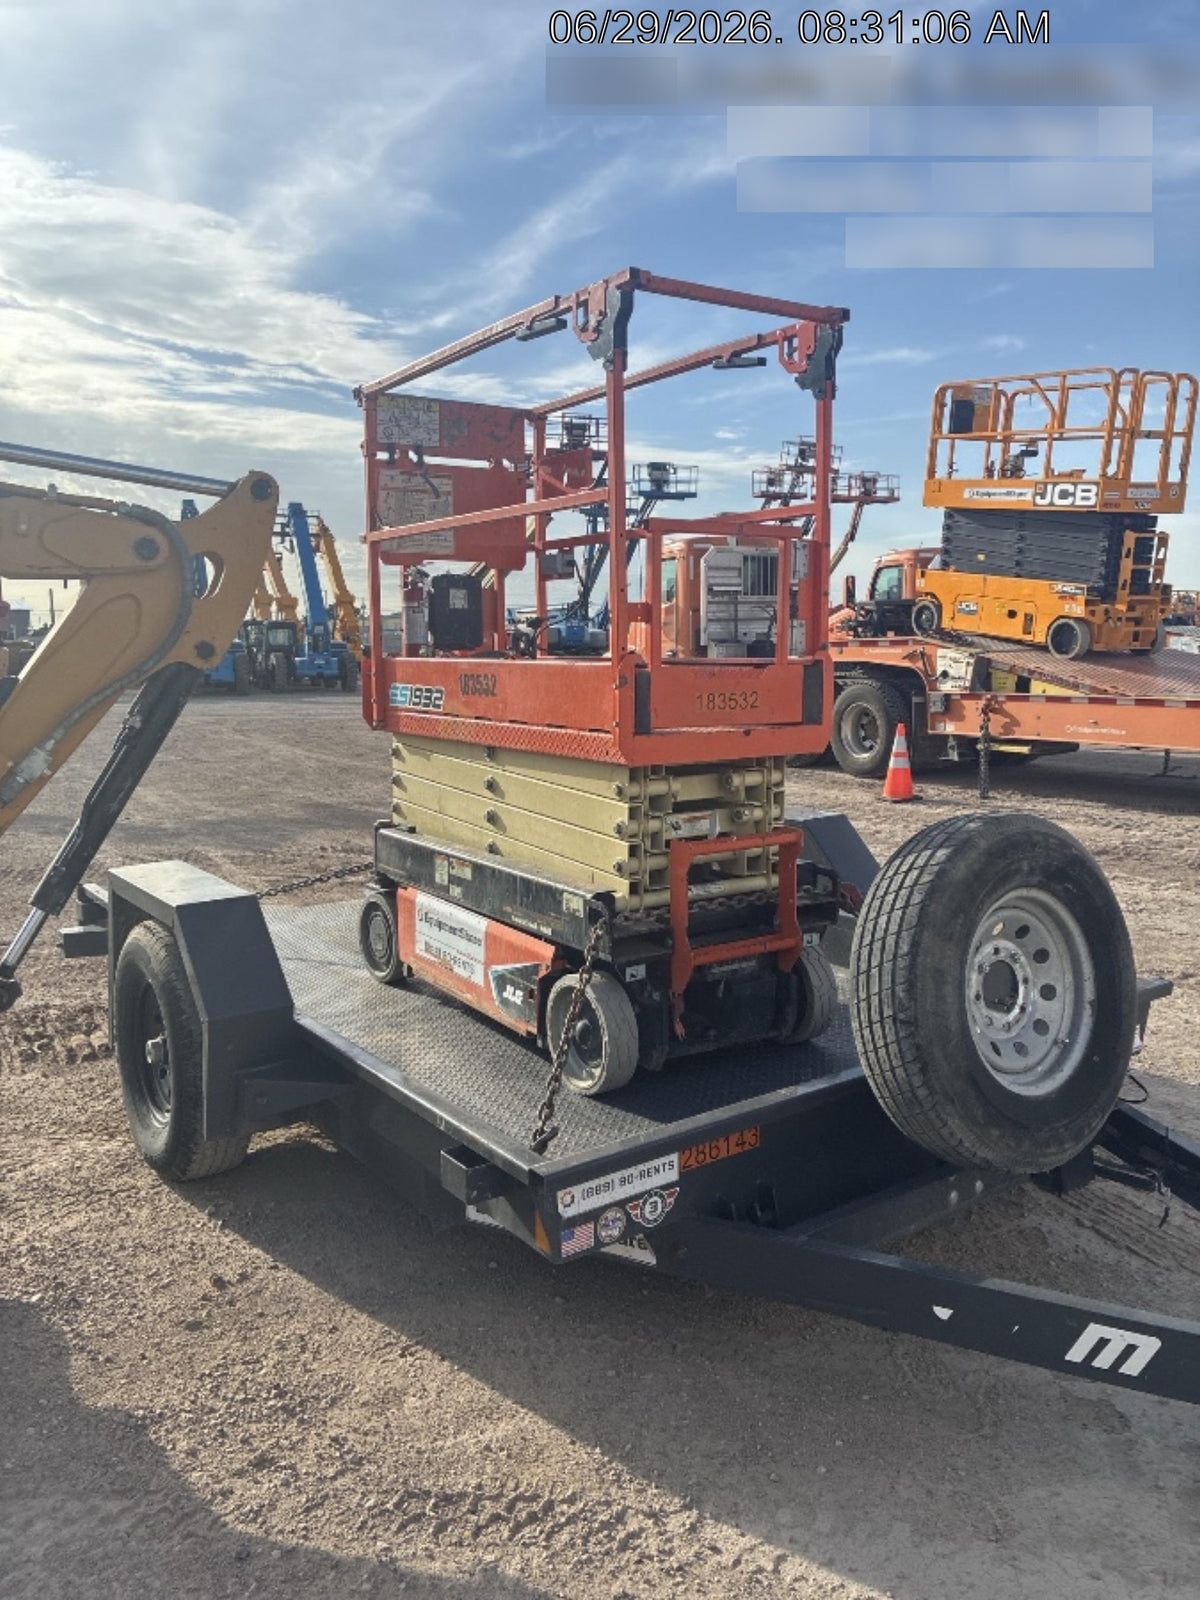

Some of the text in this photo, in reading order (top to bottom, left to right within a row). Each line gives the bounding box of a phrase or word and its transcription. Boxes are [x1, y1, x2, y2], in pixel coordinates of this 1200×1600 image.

[1034, 483, 1098, 507] JCB
[696, 691, 760, 711] 183532
[503, 984, 524, 1006] JLG
[681, 1127, 760, 1171] 286143
